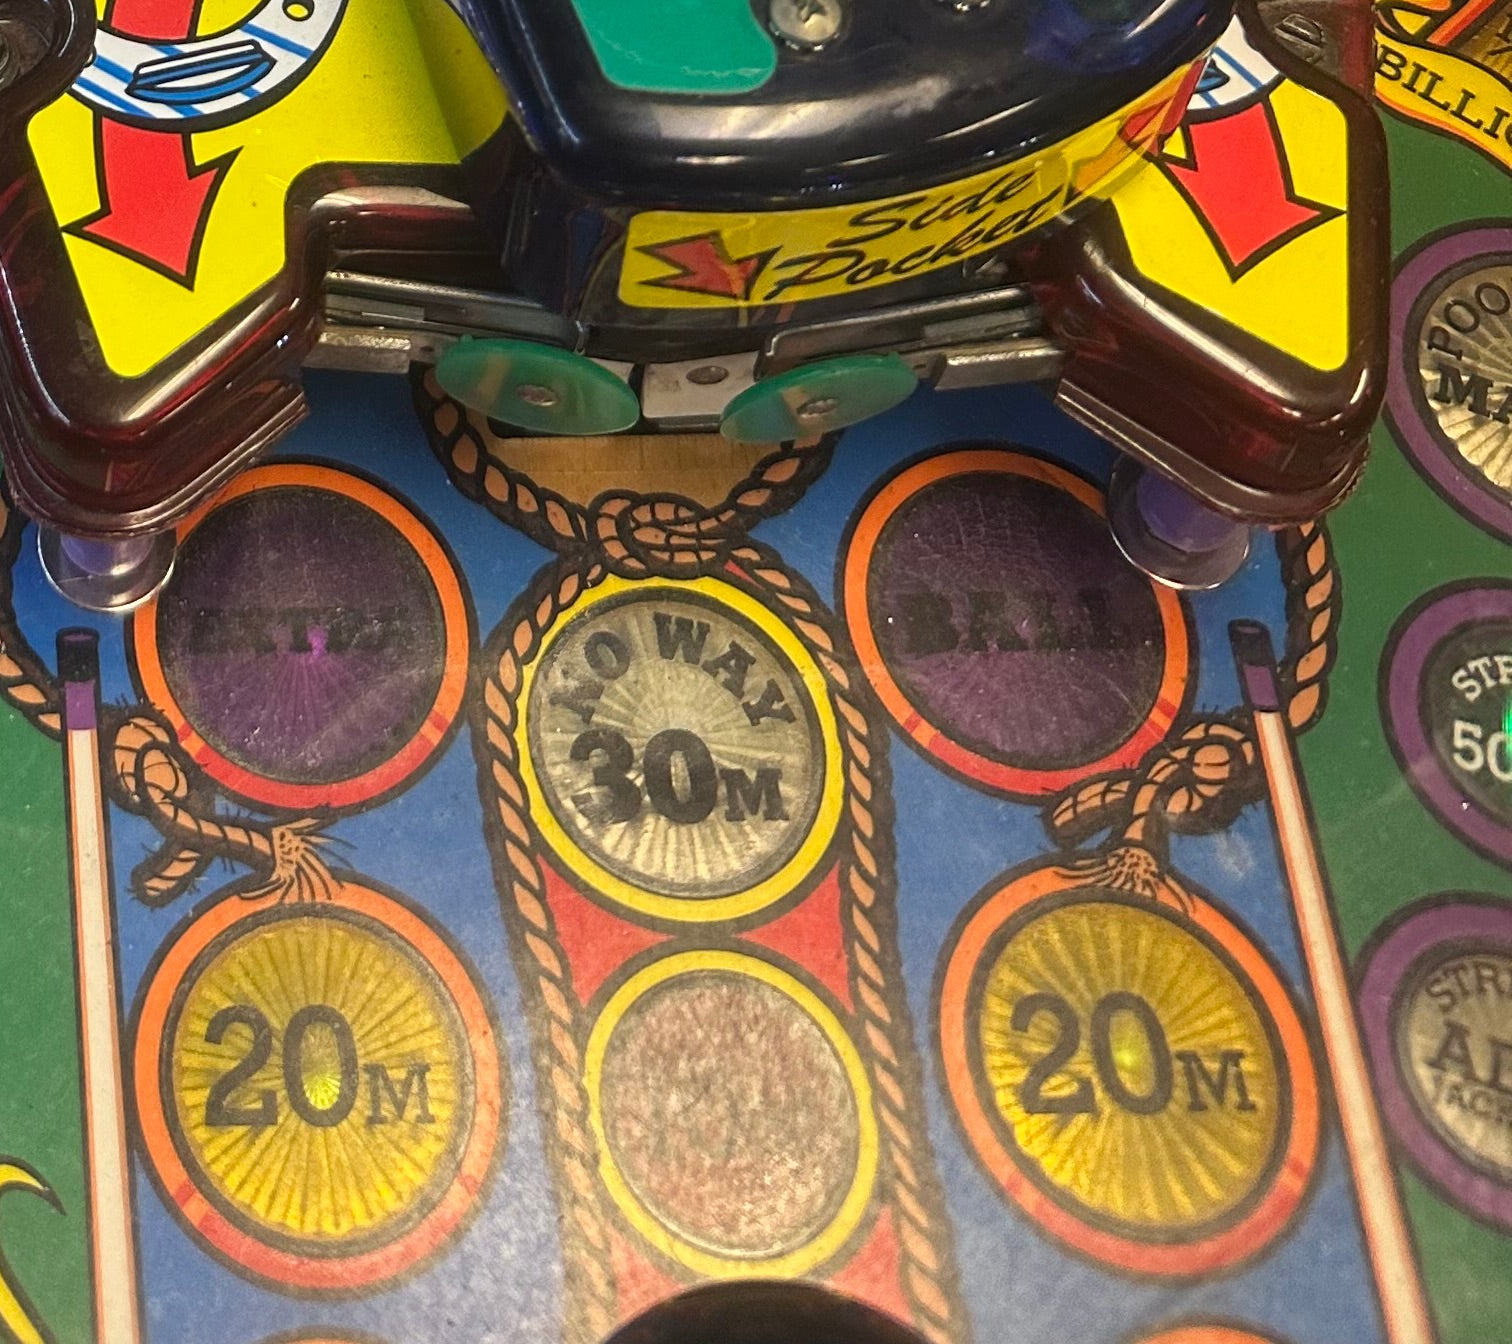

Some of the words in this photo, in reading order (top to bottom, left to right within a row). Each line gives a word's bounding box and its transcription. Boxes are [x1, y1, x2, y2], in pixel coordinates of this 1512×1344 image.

[1375, 44, 1512, 148] BILLI
[763, 182, 1065, 301] Pocket
[825, 169, 1036, 249] Side
[653, 611, 796, 727] WAY
[569, 728, 790, 824] 30M
[204, 1003, 437, 1128] 20M
[1009, 990, 1257, 1116] 20M
